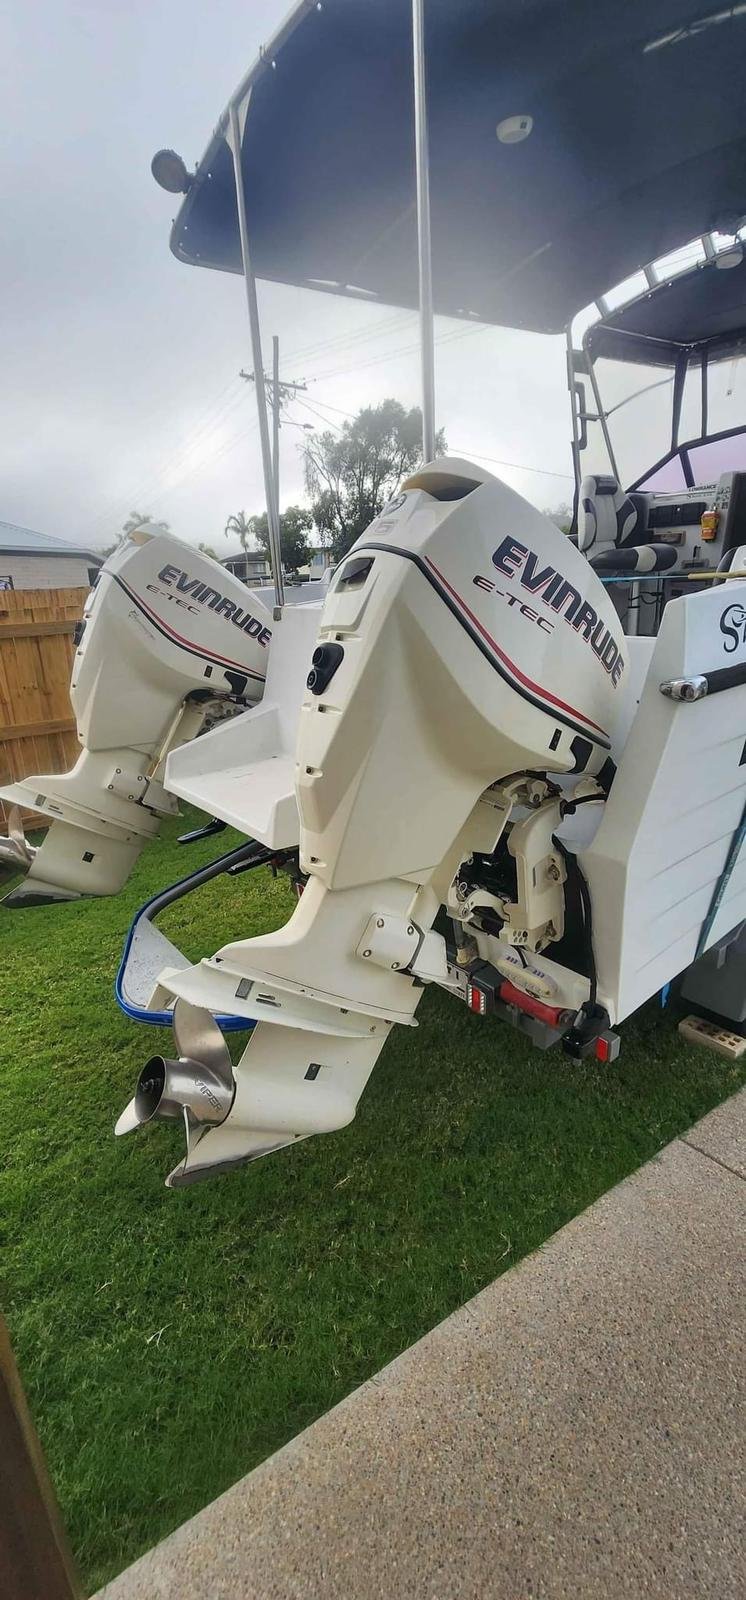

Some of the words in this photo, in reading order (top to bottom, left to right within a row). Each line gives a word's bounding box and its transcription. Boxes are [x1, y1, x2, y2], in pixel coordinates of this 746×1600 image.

[145, 584, 200, 616] E-TEC
[157, 563, 272, 648] EVINRUDE
[472, 575, 555, 634] E-TEC
[491, 535, 625, 689] EVINRUDE
[194, 1078, 223, 1113] VIPER
